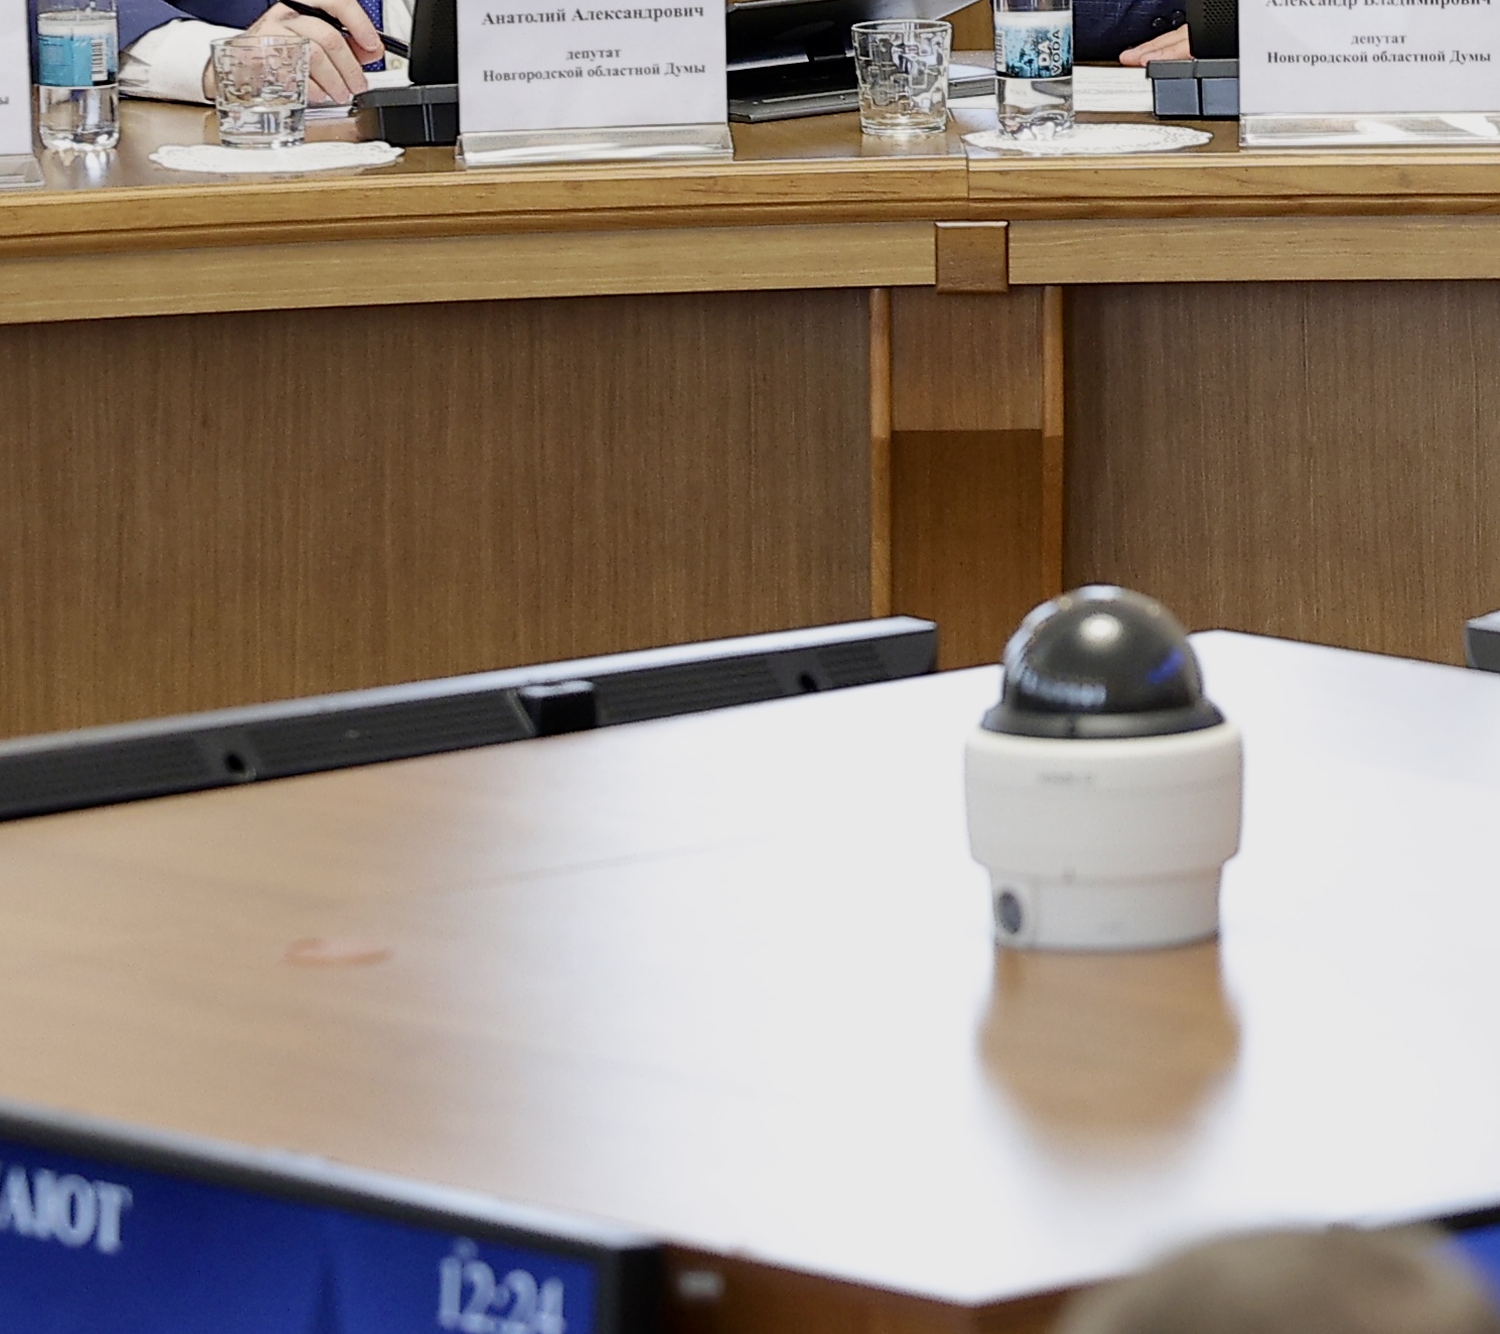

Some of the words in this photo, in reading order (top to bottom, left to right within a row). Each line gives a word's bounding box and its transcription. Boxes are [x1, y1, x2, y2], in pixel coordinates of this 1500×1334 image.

[481, 8, 567, 26] Анатолий
[571, 6, 704, 25] Александрович
[1350, 34, 1407, 47] депутат
[566, 48, 622, 62] депутат
[1052, 29, 1061, 74] VODA
[1266, 51, 1368, 66] Новгородской
[1372, 50, 1446, 63] областной
[1449, 50, 1491, 65] Думы
[483, 67, 583, 83] Новгородской
[587, 64, 660, 79] областной
[664, 62, 706, 77] Думы
